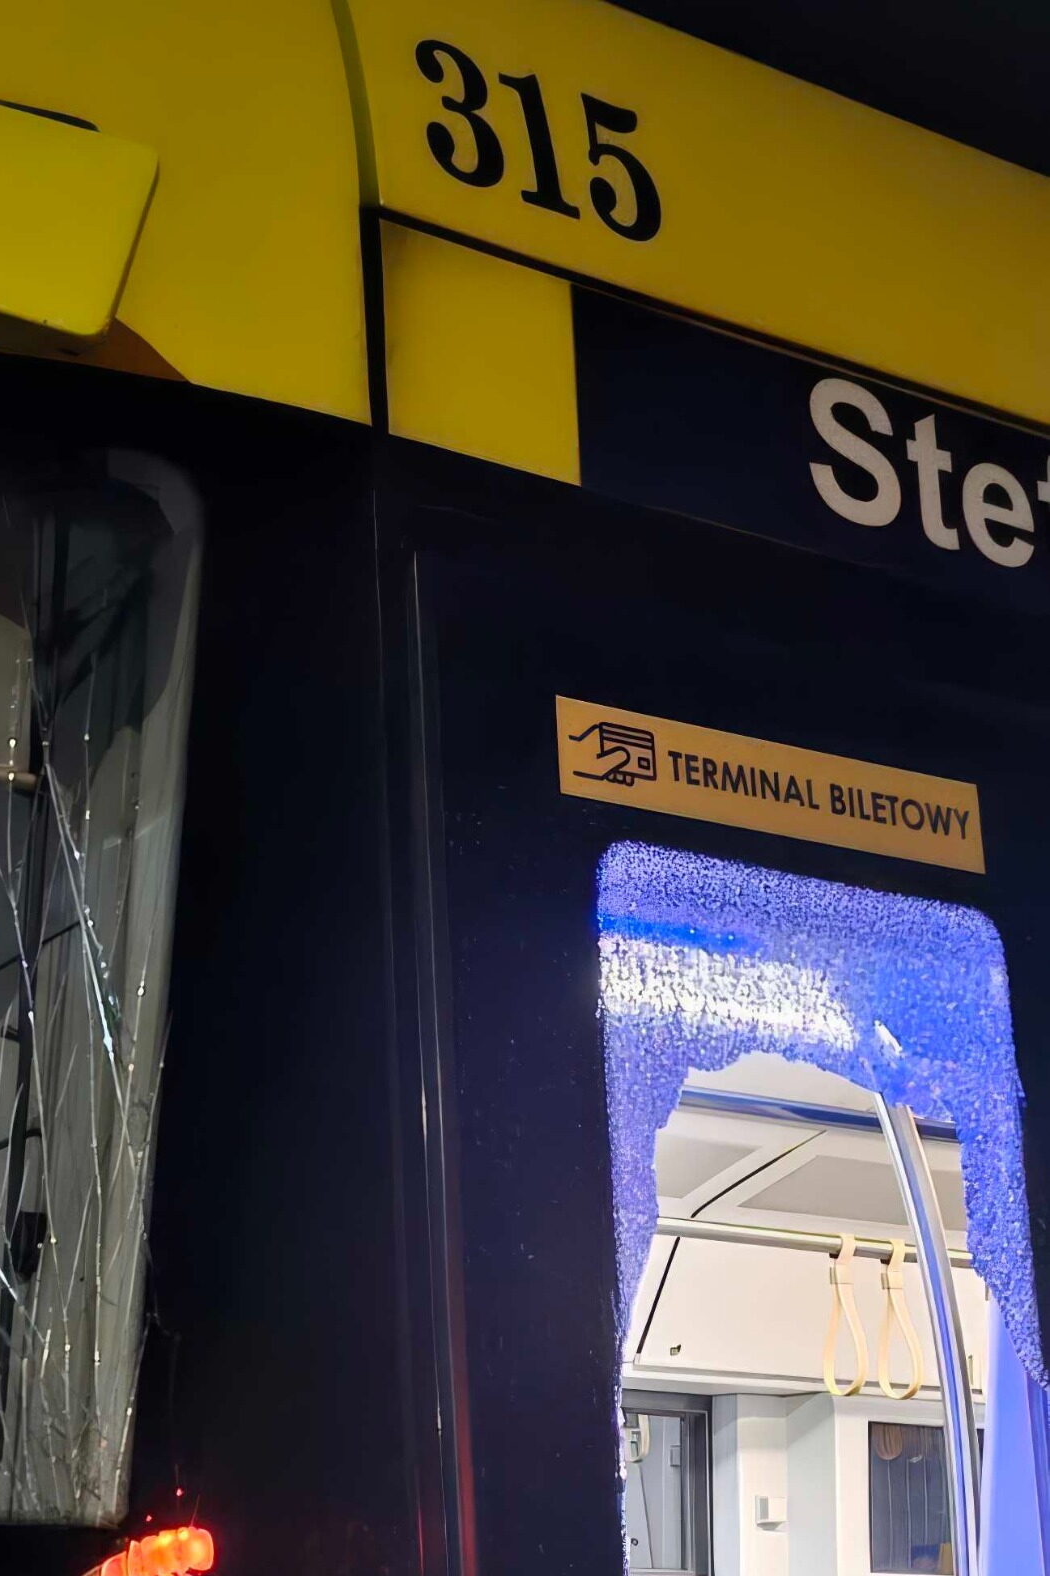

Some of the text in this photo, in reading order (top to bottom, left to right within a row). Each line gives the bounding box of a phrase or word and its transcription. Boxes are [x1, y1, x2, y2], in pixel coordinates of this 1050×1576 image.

[415, 38, 663, 242] 315
[667, 750, 970, 840] TERMINAL BILETOWY
